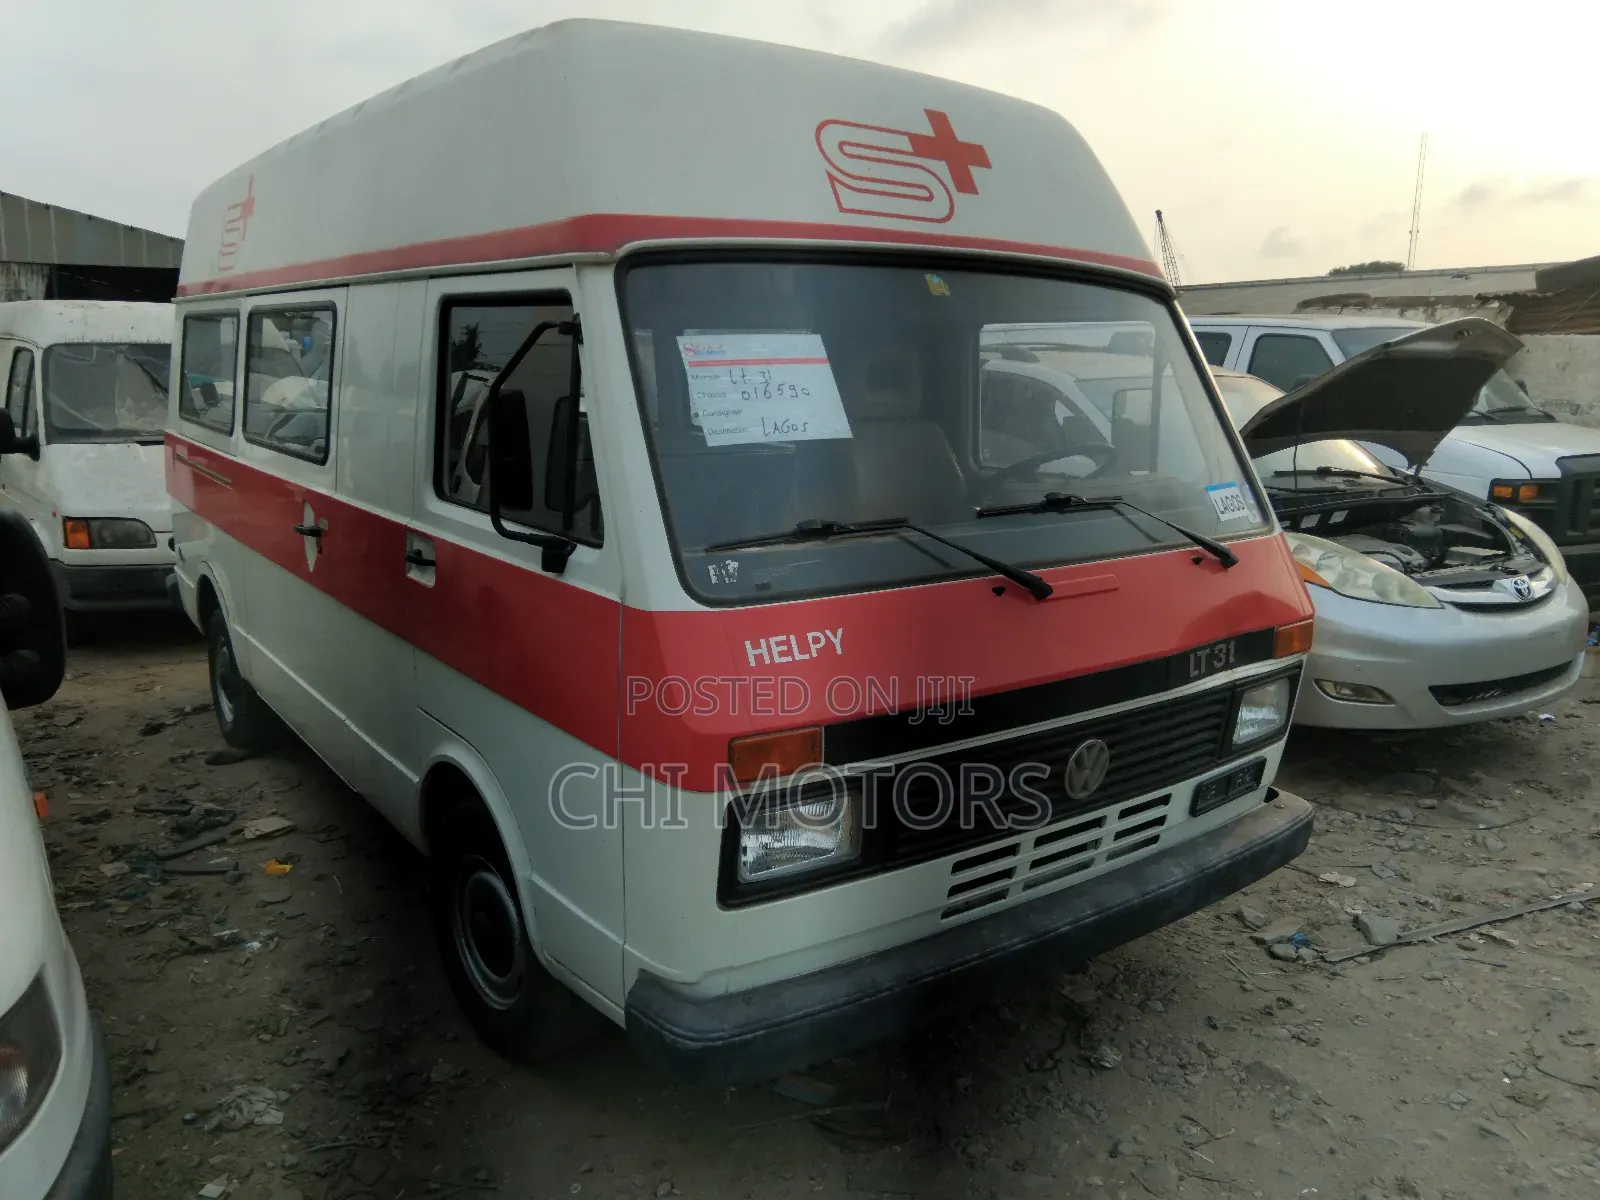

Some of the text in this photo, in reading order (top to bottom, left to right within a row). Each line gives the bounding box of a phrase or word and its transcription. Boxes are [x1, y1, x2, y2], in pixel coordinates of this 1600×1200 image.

[741, 383, 810, 400] 016590
[1213, 493, 1246, 515] LAGOS
[744, 627, 844, 667] HELPY
[1189, 640, 1236, 678] LT 31
